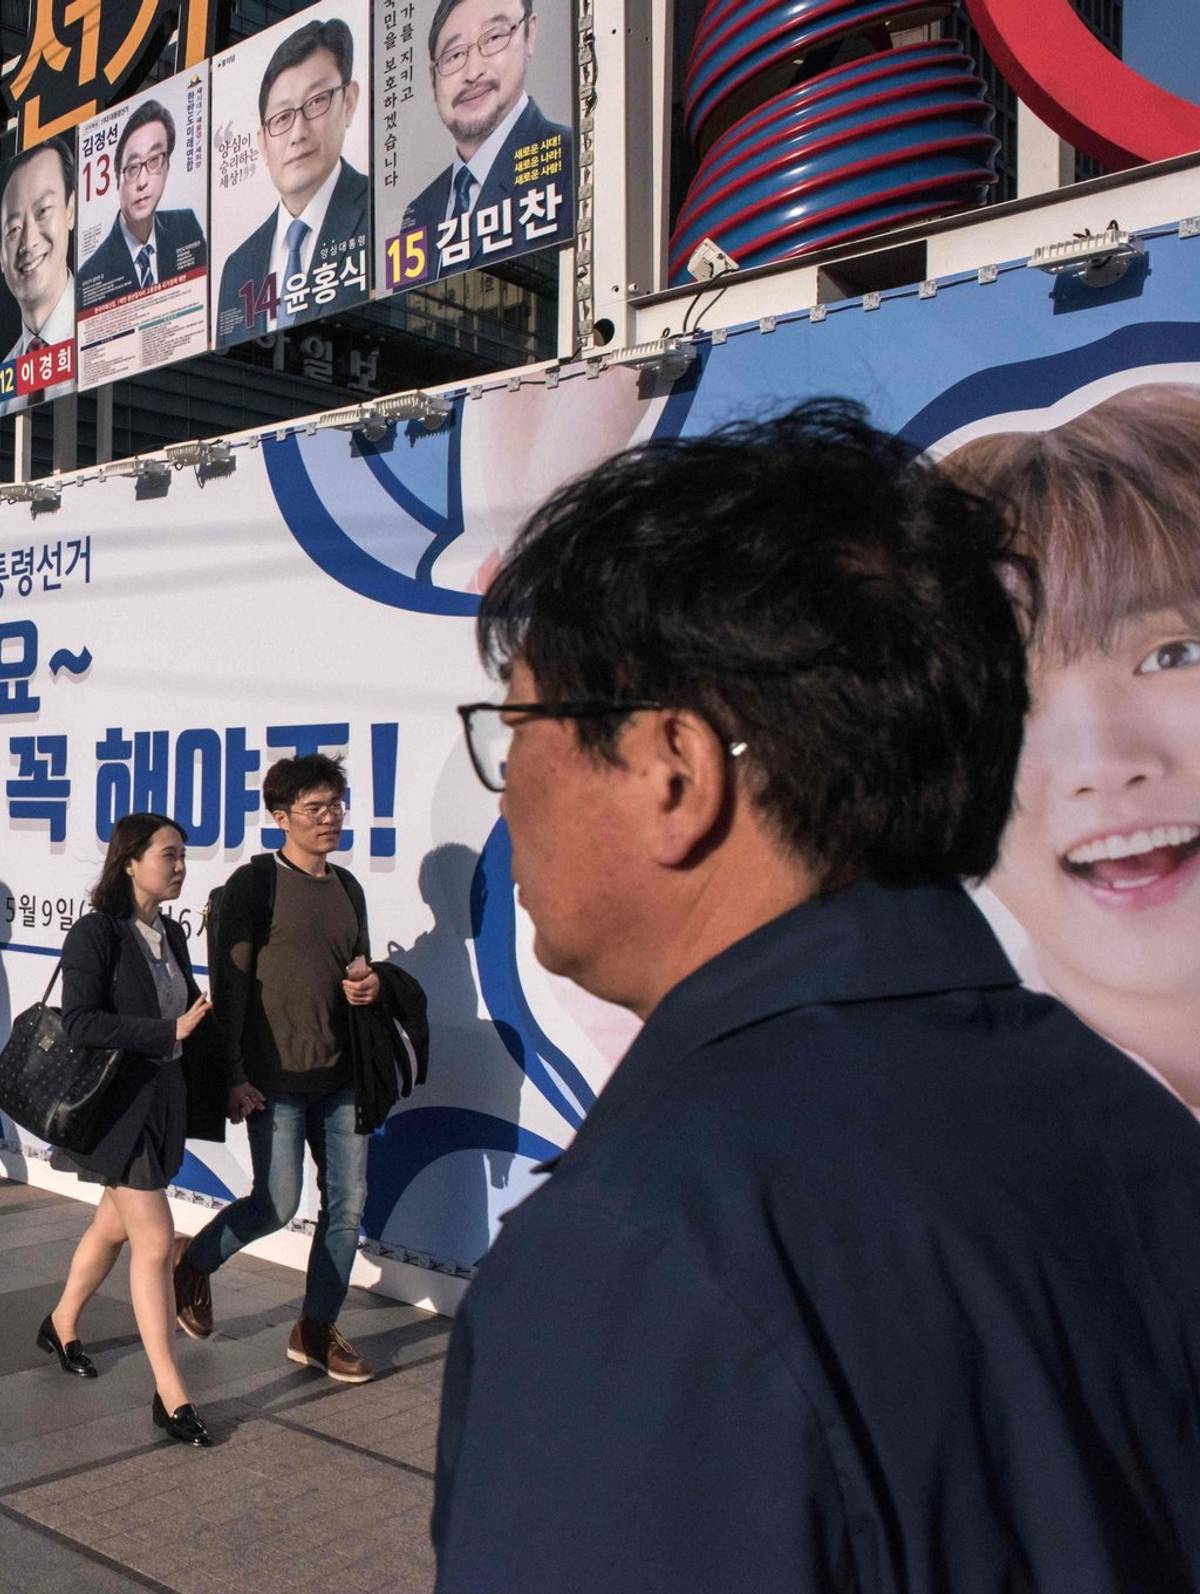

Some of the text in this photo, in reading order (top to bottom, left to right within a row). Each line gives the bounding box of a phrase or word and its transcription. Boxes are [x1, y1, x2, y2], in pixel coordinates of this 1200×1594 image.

[401, 47, 414, 103] 지키고
[82, 123, 118, 157] 김정선
[219, 133, 251, 159] 양심이
[384, 57, 398, 188] 보호하겠습니다
[82, 154, 111, 201] 13
[220, 149, 260, 175] 승리하는
[436, 183, 563, 267] 김민찬
[284, 250, 366, 315] 윤홍식
[388, 231, 426, 284] 15
[239, 271, 281, 329] 14
[0, 367, 14, 394] 12
[21, 347, 72, 384] 이경희
[215, 331, 381, 395] 아일보
[6, 735, 71, 842] 꼭
